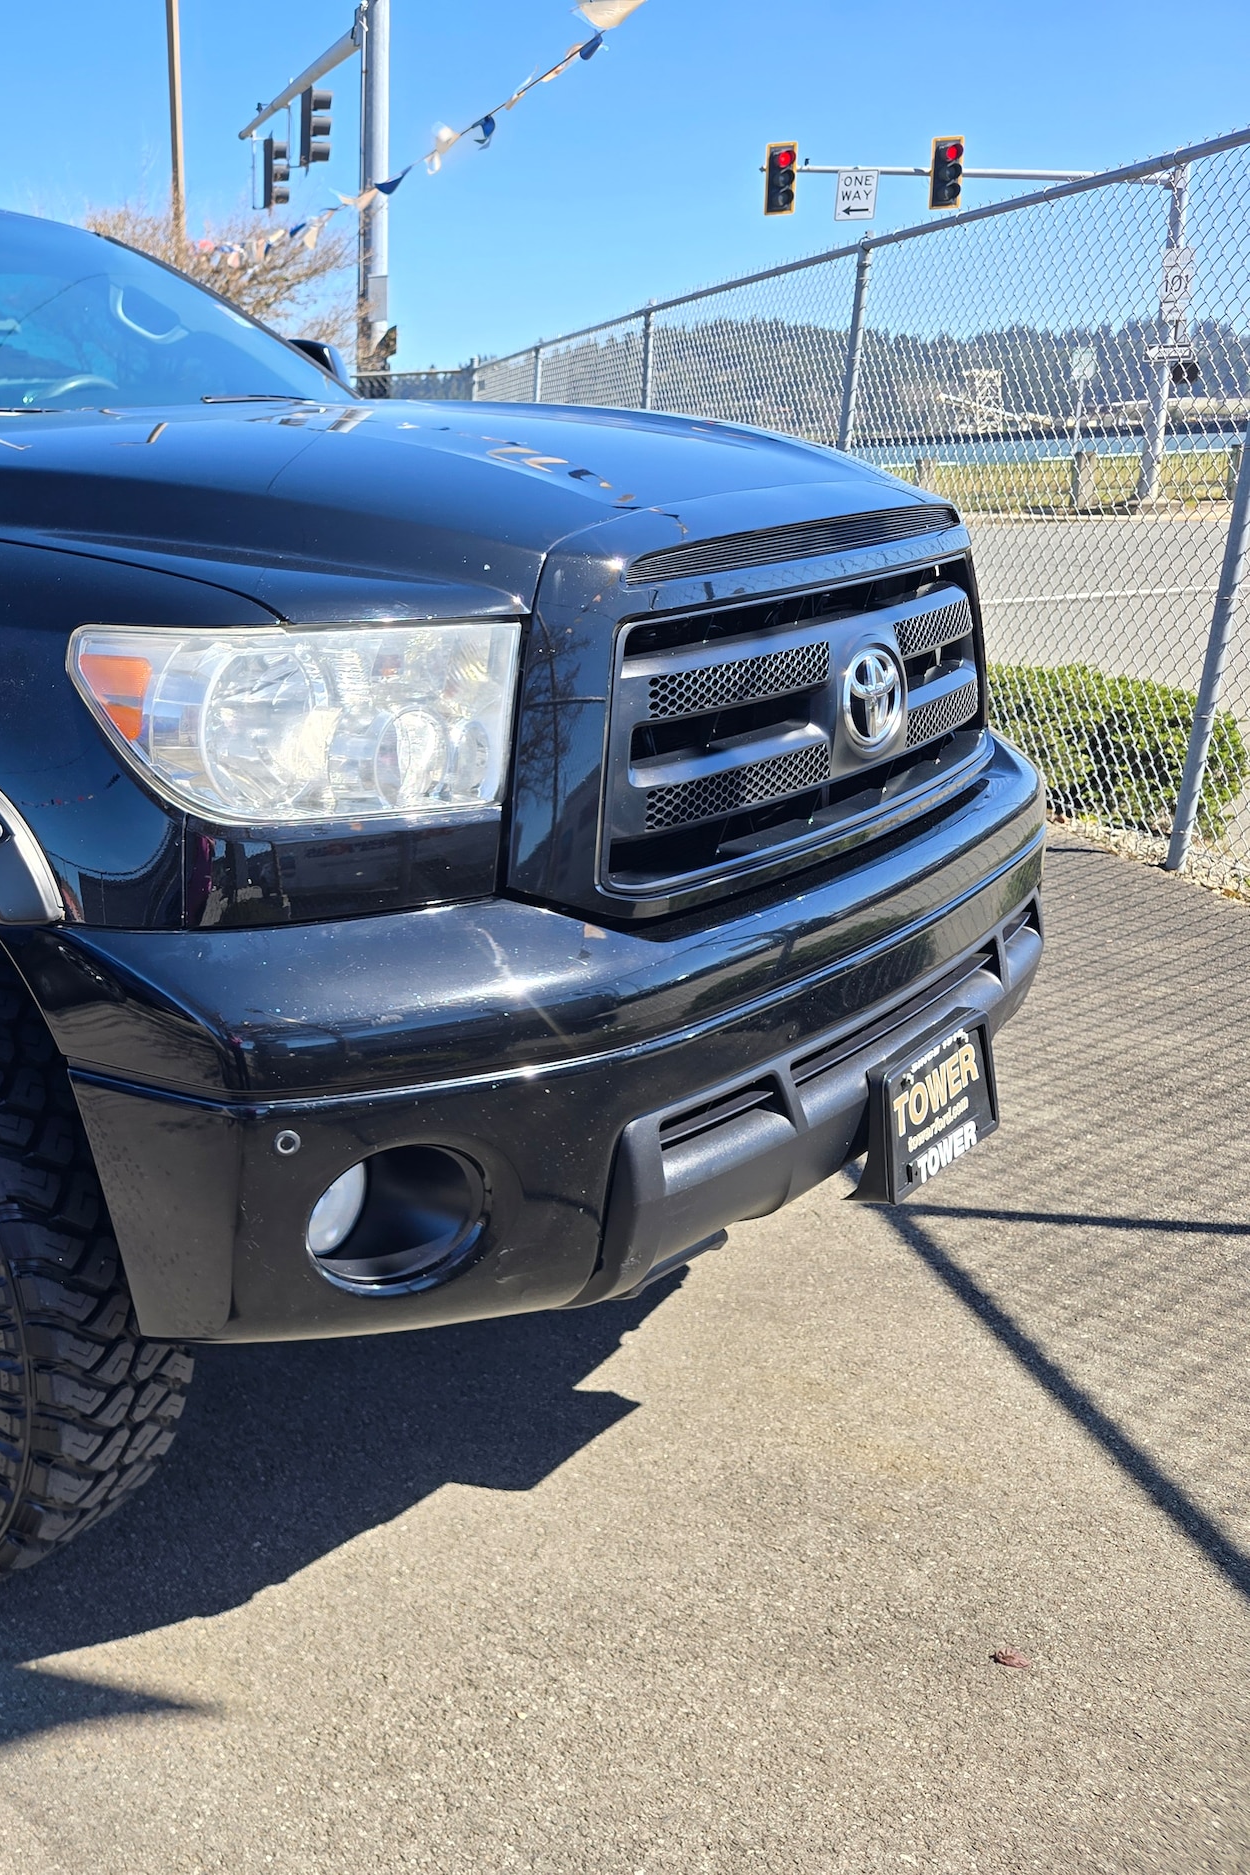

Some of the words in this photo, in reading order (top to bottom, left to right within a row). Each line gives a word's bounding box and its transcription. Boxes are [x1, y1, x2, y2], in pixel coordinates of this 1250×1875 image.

[841, 189, 873, 202] WAY
[843, 174, 873, 187] ONE
[893, 1043, 980, 1137] TOWER
[907, 1096, 969, 1153] towerford.com
[916, 1120, 978, 1184] TOWER
